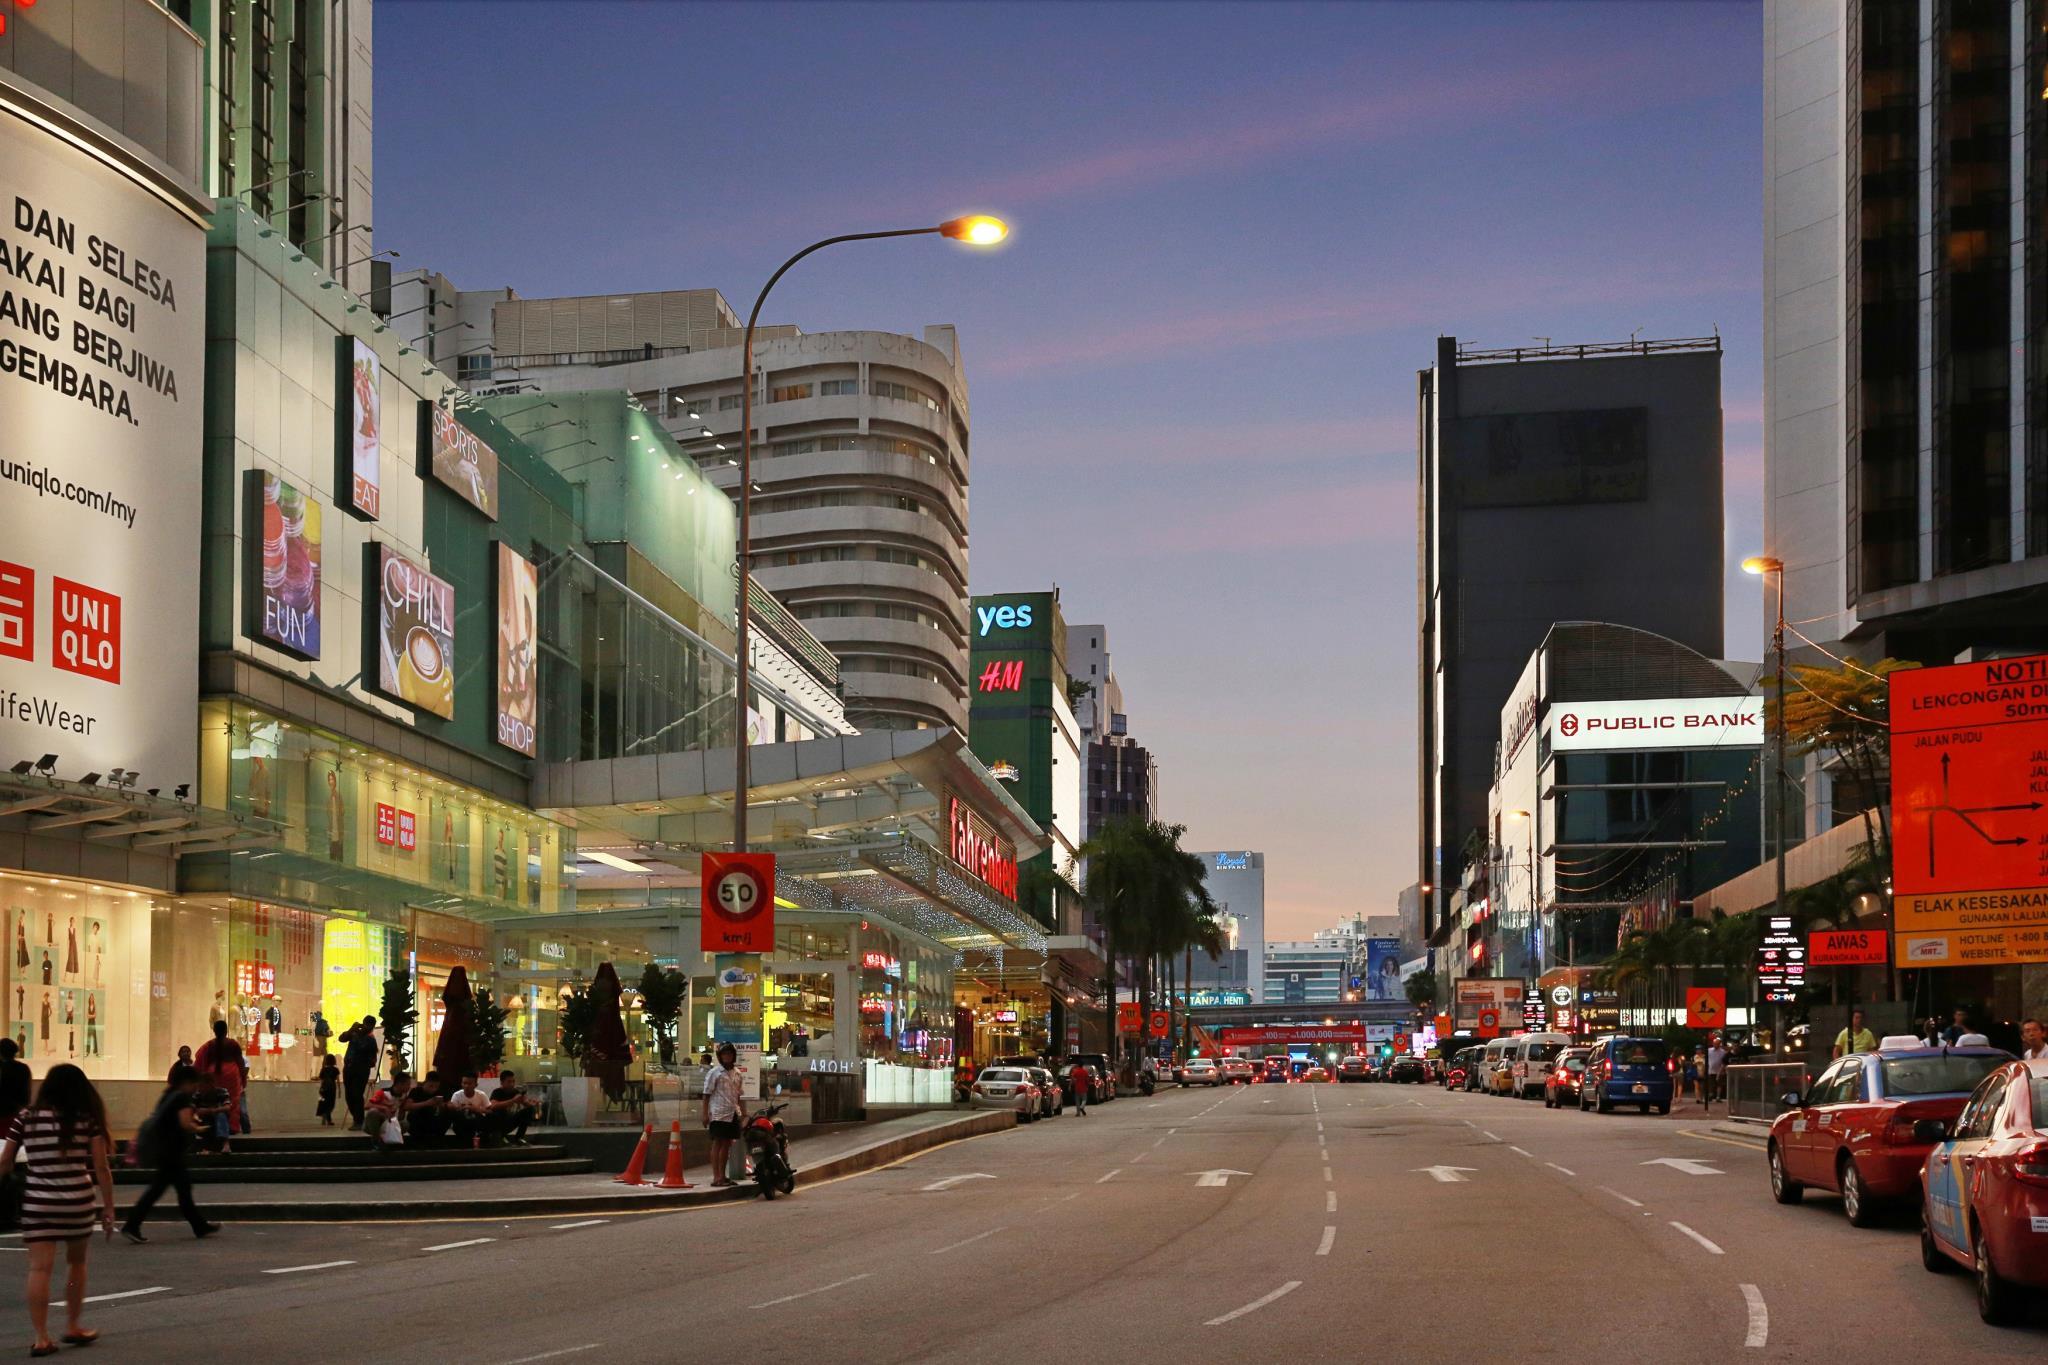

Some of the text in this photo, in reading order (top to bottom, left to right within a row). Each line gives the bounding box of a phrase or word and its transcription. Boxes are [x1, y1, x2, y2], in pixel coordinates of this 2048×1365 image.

[15, 196, 176, 312] DAN SELESA
[78, 275, 136, 333] BAGI
[0, 290, 178, 402] ANG BERJIWA
[0, 338, 139, 427] GEMBARA.
[433, 410, 478, 466] SPORTS
[1, 459, 137, 529] uniqlo.com/my
[353, 474, 379, 513] EAT
[61, 590, 109, 634] UNI
[383, 557, 452, 638] CHILL
[266, 596, 306, 647] FUN
[977, 603, 1032, 637] yes
[61, 629, 114, 670] QLO
[978, 660, 1024, 692] H&M
[1986, 659, 2048, 682] NOTI
[1912, 687, 2025, 710] LENCONGAN
[499, 713, 535, 752] SHOP
[1586, 712, 1758, 731] PUBLIC BANK
[1914, 731, 1983, 748] JALAN PUDU
[722, 883, 753, 903] 50
[1914, 900, 1953, 913] ELAK
[1959, 910, 2048, 924] GUNAKAN LALUA
[1827, 934, 1869, 950] AWAS
[1959, 934, 2004, 945] HOTLINE
[2013, 931, 2040, 942] 1-800
[1960, 949, 2007, 959] WEBSITE
[1223, 996, 1244, 1006] HENTI
